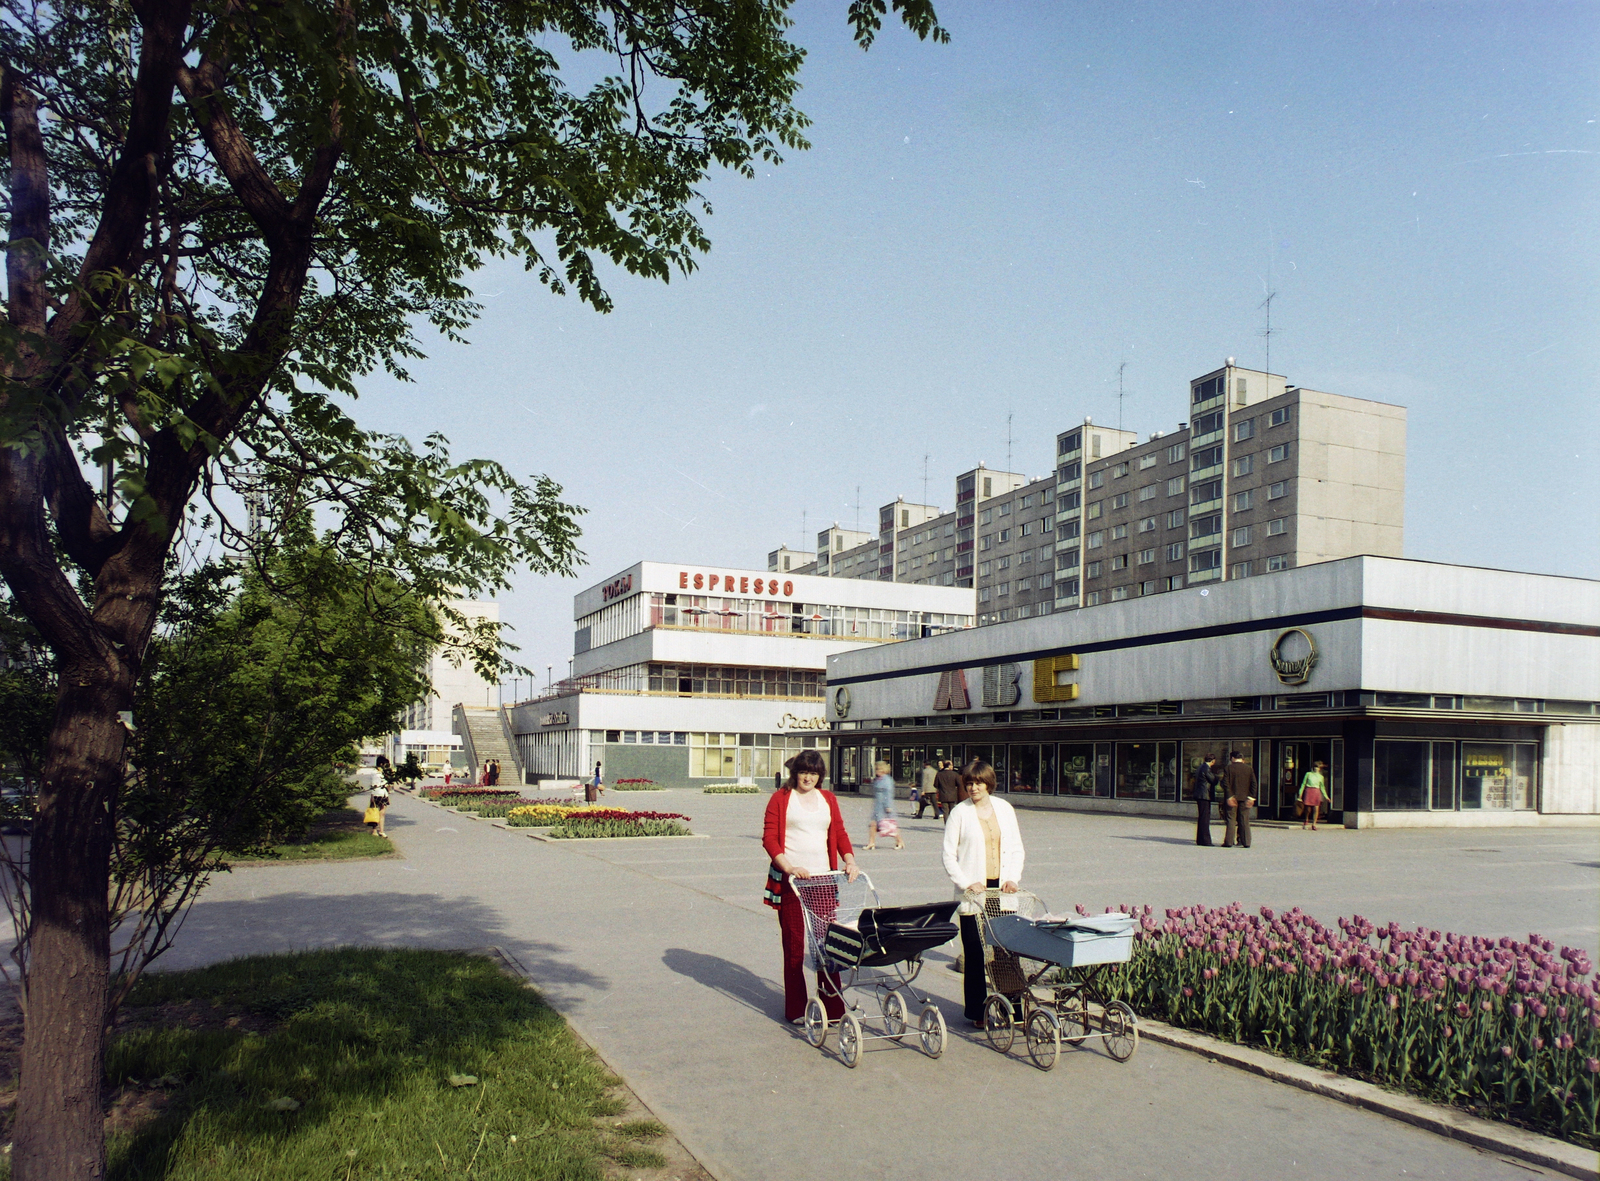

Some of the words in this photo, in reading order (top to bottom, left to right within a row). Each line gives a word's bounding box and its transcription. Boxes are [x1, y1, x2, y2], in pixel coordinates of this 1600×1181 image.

[602, 574, 632, 602] TOKAJ
[679, 571, 794, 597] ESPRESSO
[932, 653, 1080, 711] ABC
